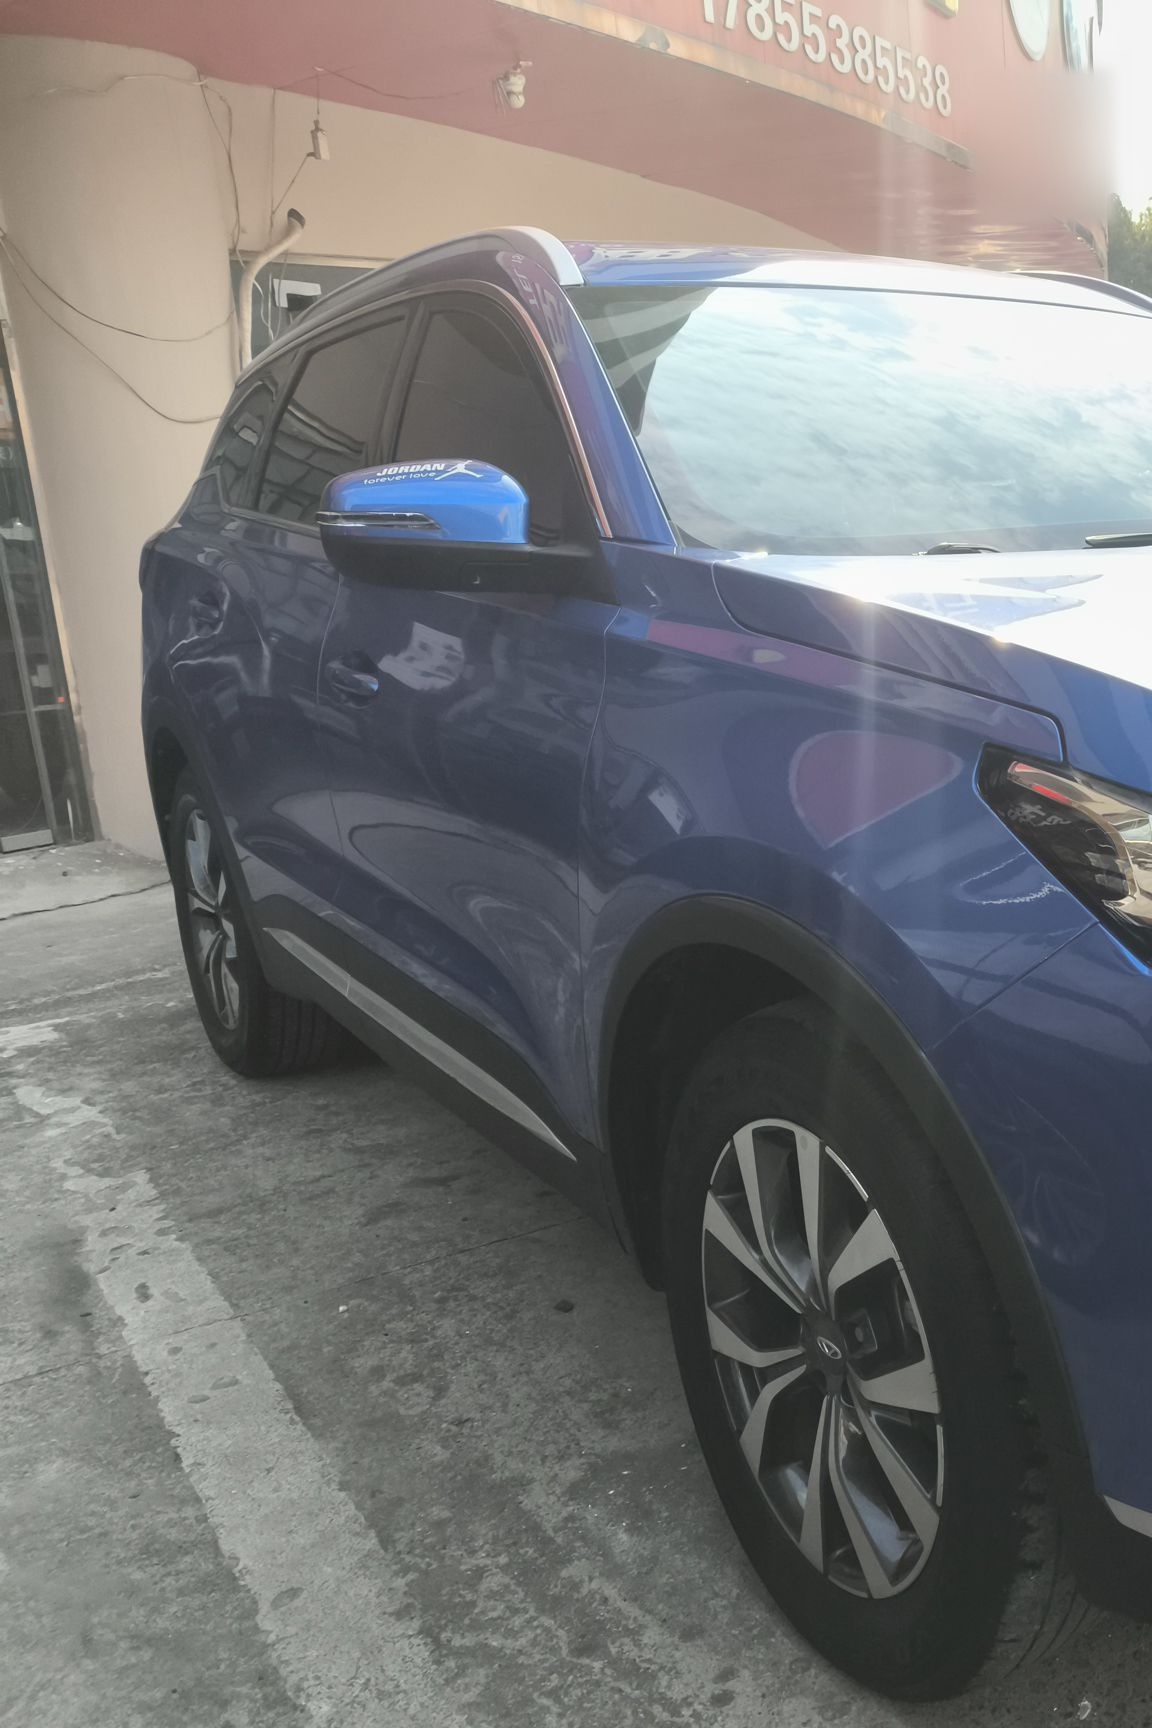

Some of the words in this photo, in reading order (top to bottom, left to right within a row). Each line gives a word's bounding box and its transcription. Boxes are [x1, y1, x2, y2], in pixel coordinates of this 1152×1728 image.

[376, 463, 446, 477] JORDAN
[363, 474, 407, 485] forever
[409, 472, 437, 480] love
